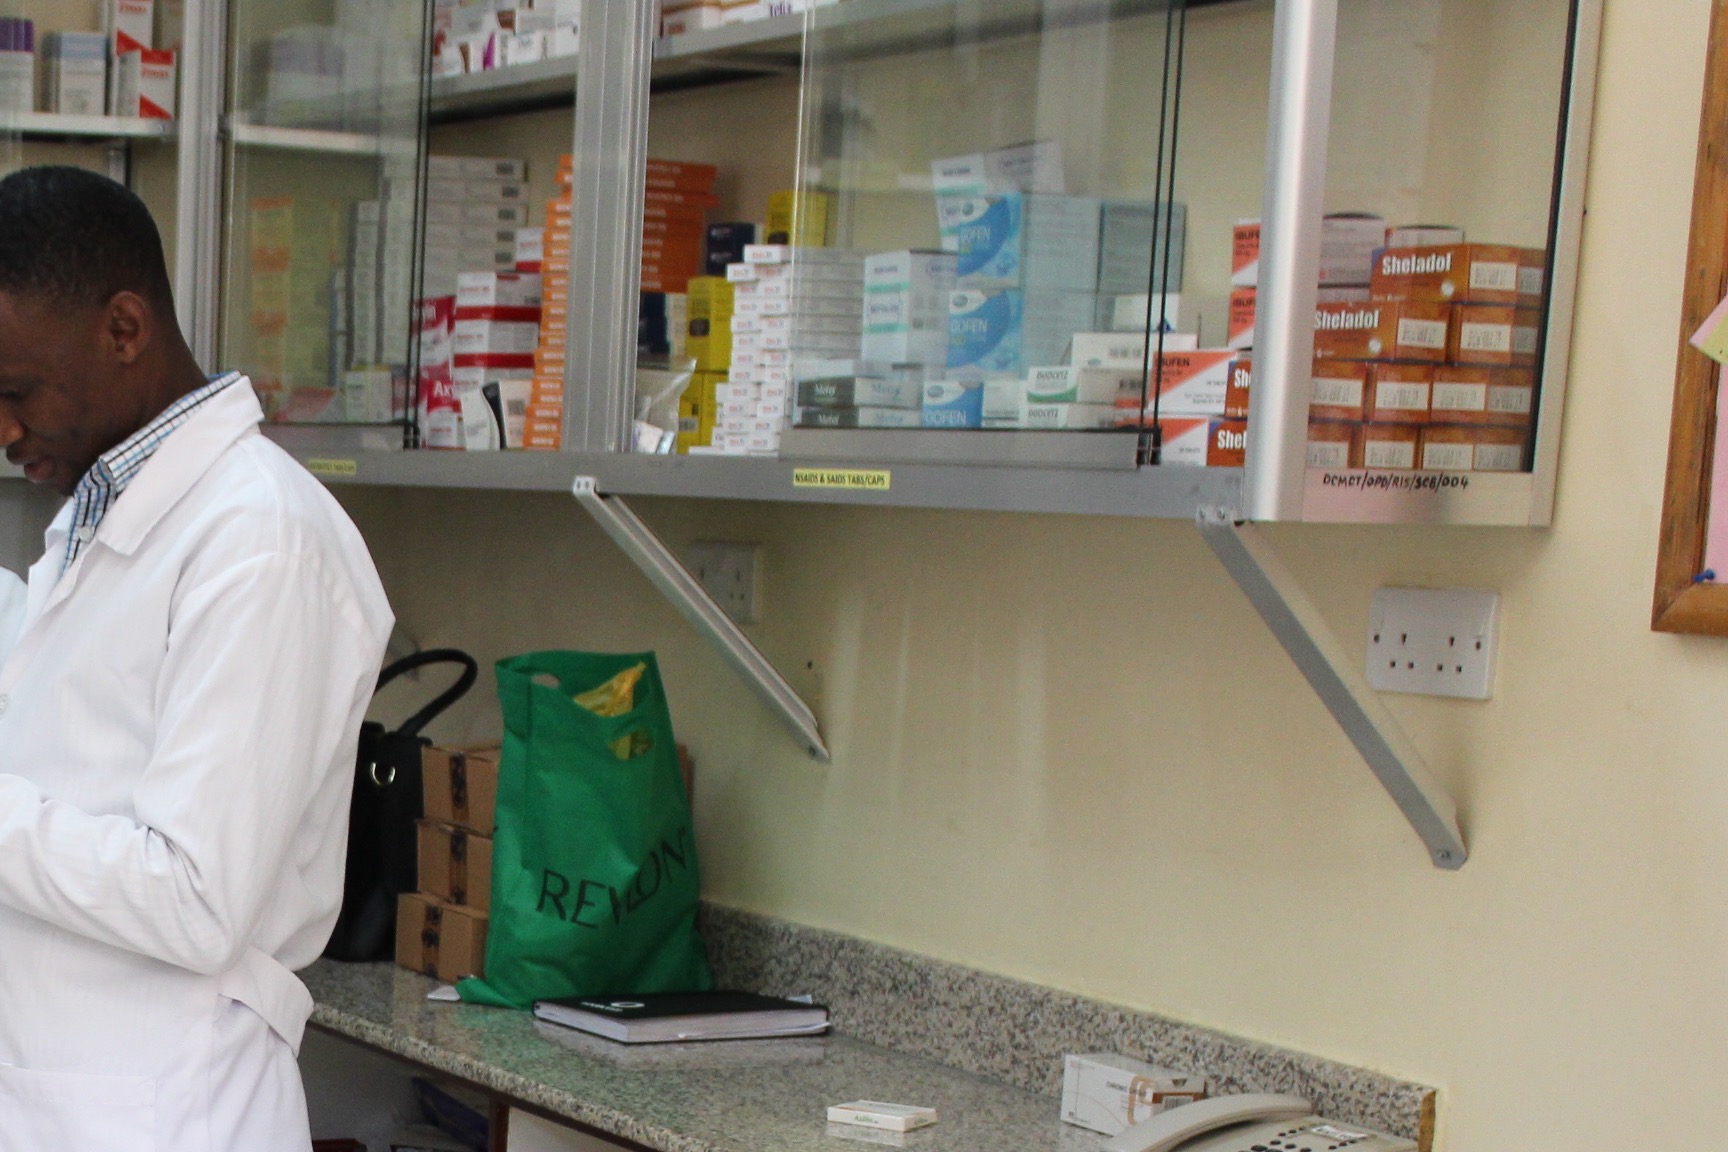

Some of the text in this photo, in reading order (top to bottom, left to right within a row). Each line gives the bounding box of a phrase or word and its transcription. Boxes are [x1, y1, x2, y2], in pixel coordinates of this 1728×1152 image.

[1382, 252, 1452, 276] Sheladol
[1314, 309, 1381, 330] Sheladol
[925, 411, 967, 425] GOFEN
[795, 473, 819, 483] NSAIDS
[826, 475, 846, 485] SAIDS
[848, 475, 886, 487] TABS/CAPS
[536, 826, 688, 930] REVLON
